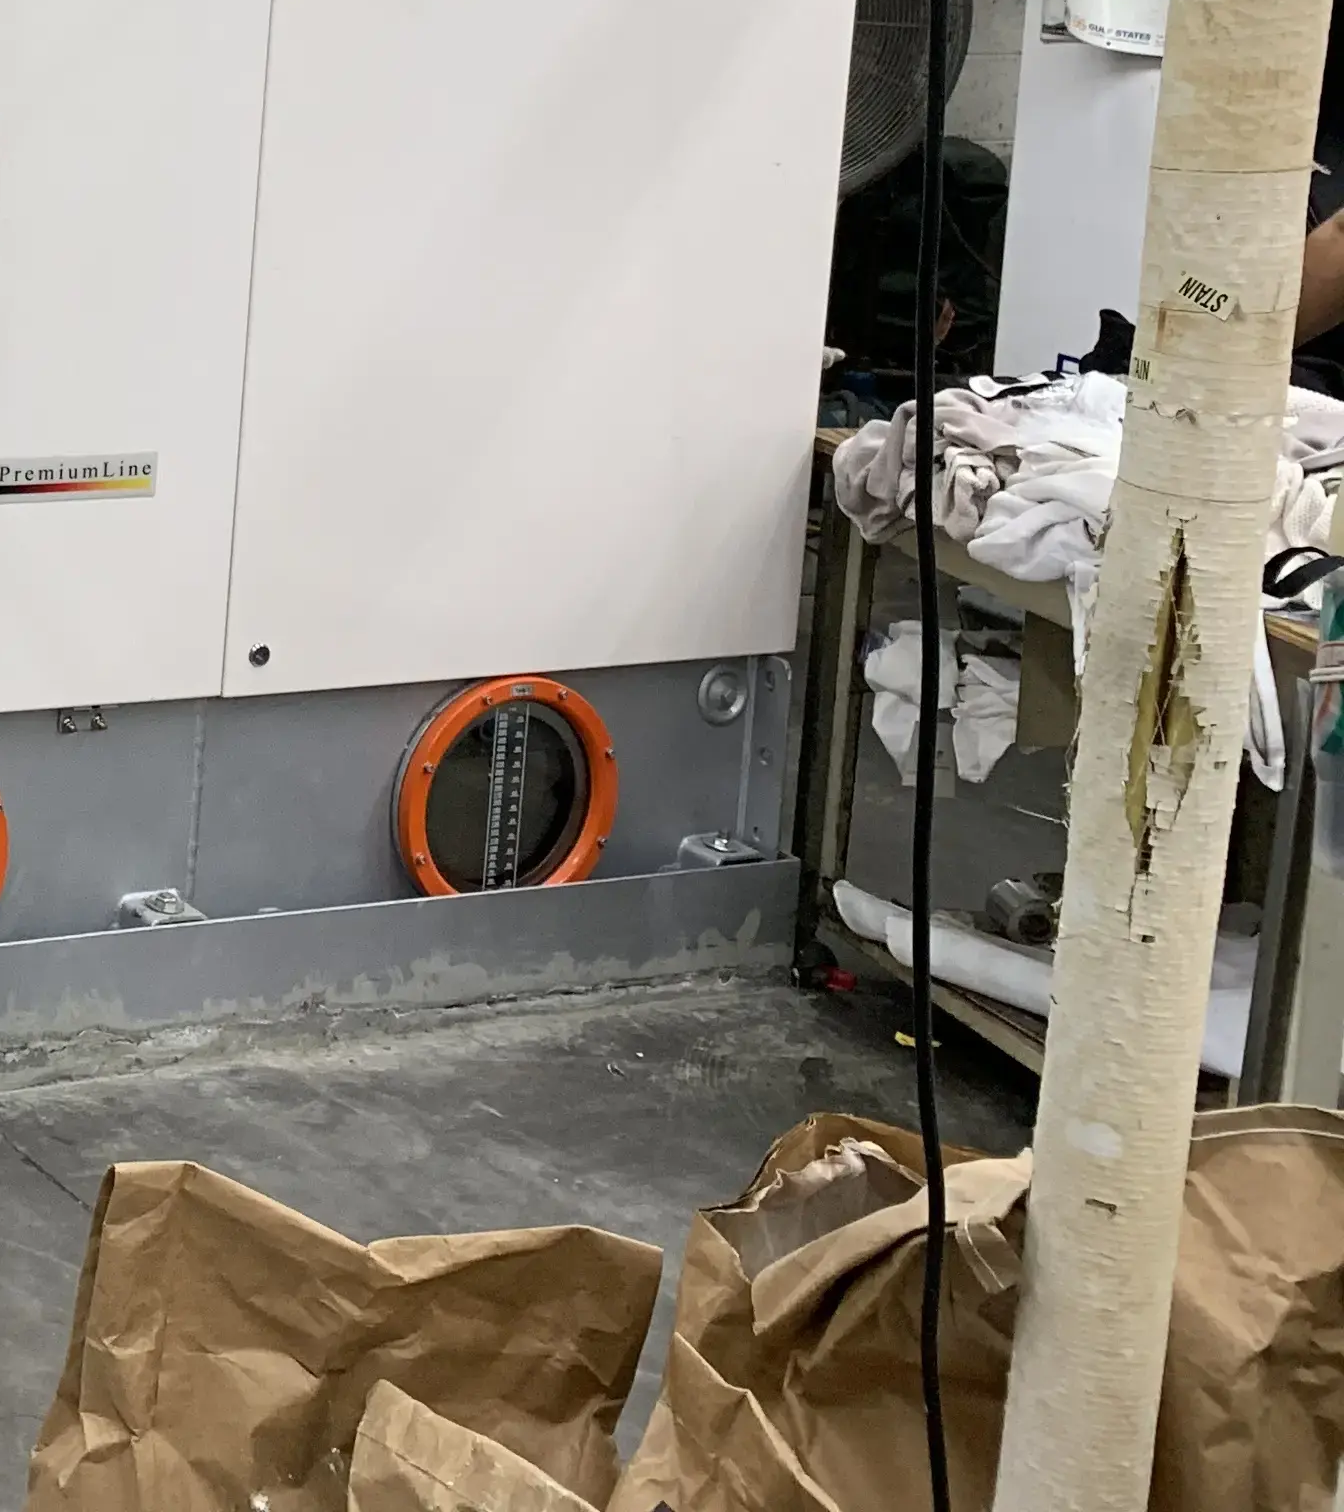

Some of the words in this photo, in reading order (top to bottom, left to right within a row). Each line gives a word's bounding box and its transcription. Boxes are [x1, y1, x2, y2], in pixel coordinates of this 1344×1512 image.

[1115, 29, 1151, 41] STATES
[1178, 277, 1229, 313] STAIN
[0, 460, 152, 482] PremiumLine
